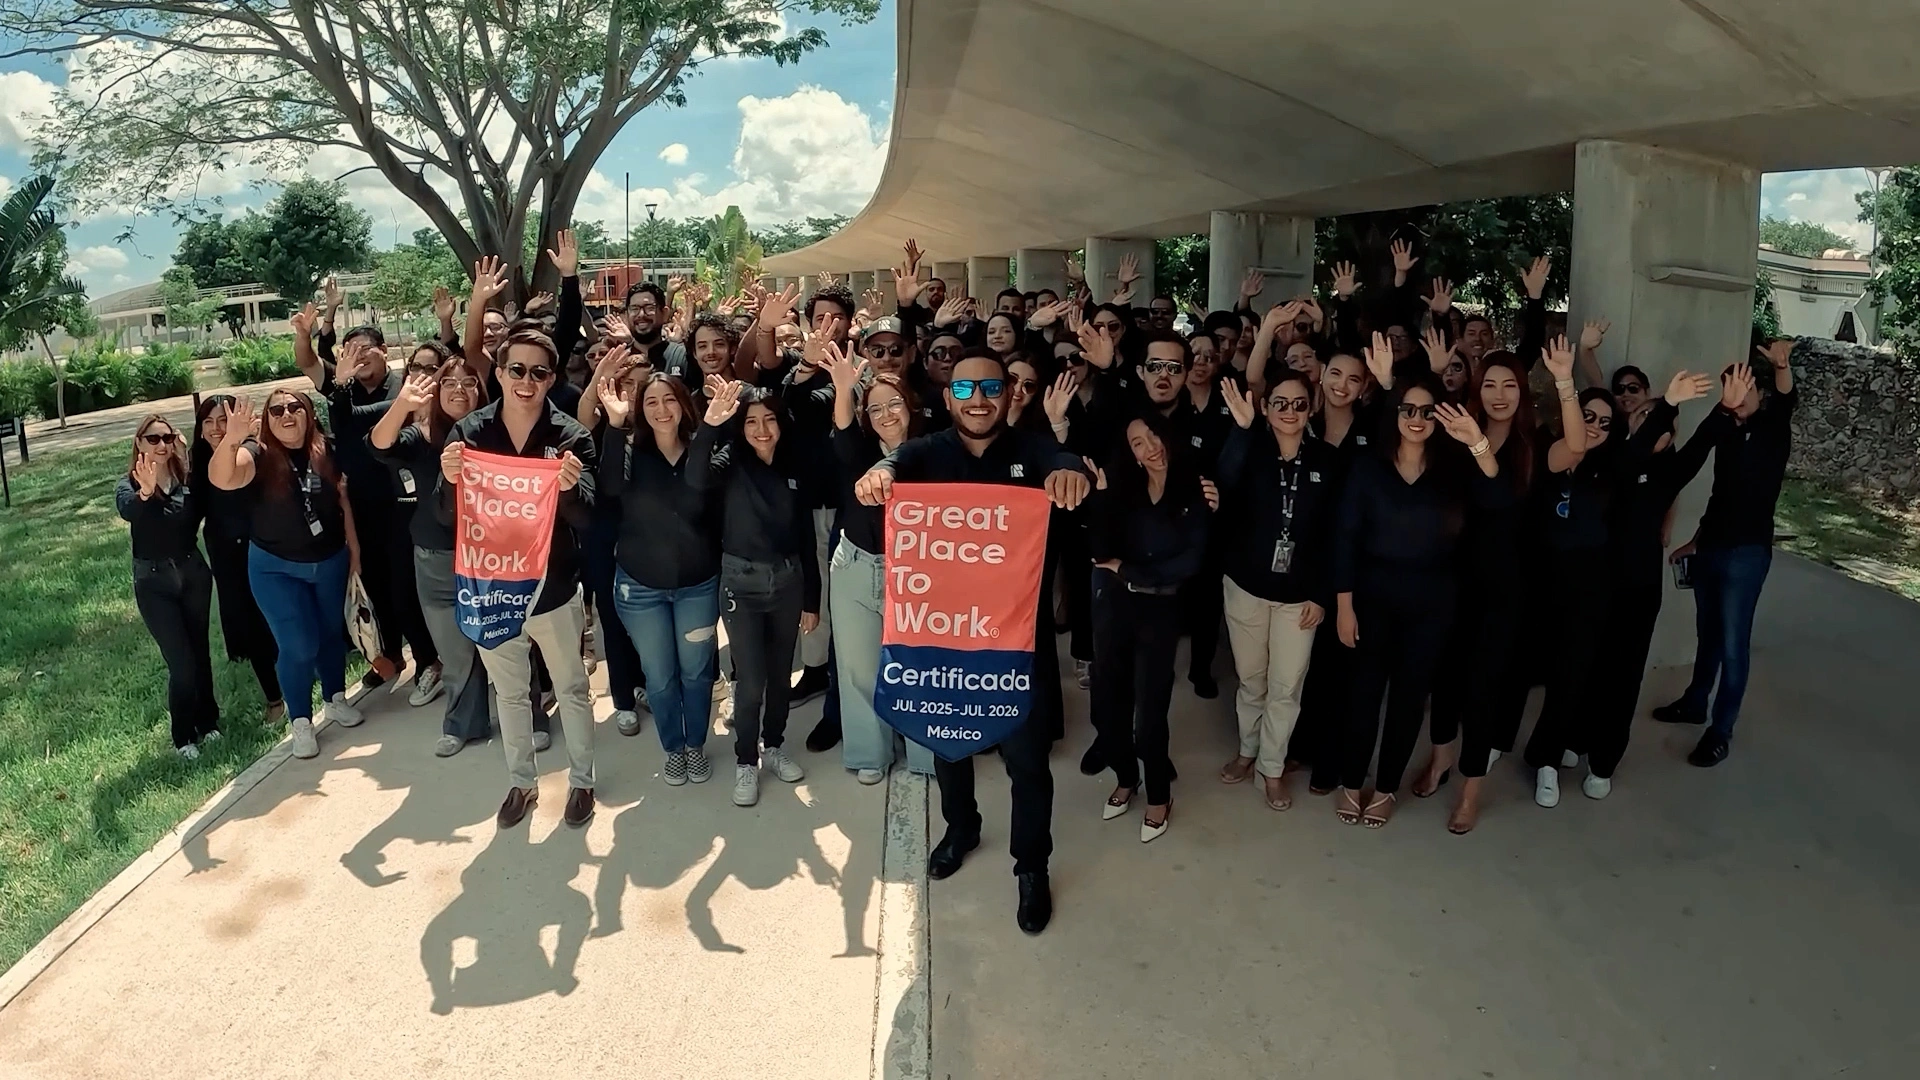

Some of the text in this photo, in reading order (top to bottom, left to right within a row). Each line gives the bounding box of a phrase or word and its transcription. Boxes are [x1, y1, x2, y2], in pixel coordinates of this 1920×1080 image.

[461, 462, 543, 495] Great
[463, 488, 538, 520] Place
[893, 501, 1010, 531] Great
[462, 514, 486, 542] To
[894, 530, 1006, 564] Place
[891, 565, 932, 595] To
[463, 615, 481, 626] JUL
[883, 662, 1030, 692] Certificada
[891, 699, 916, 713] JUL
[989, 704, 1019, 717] 2026
[926, 725, 982, 741] México
